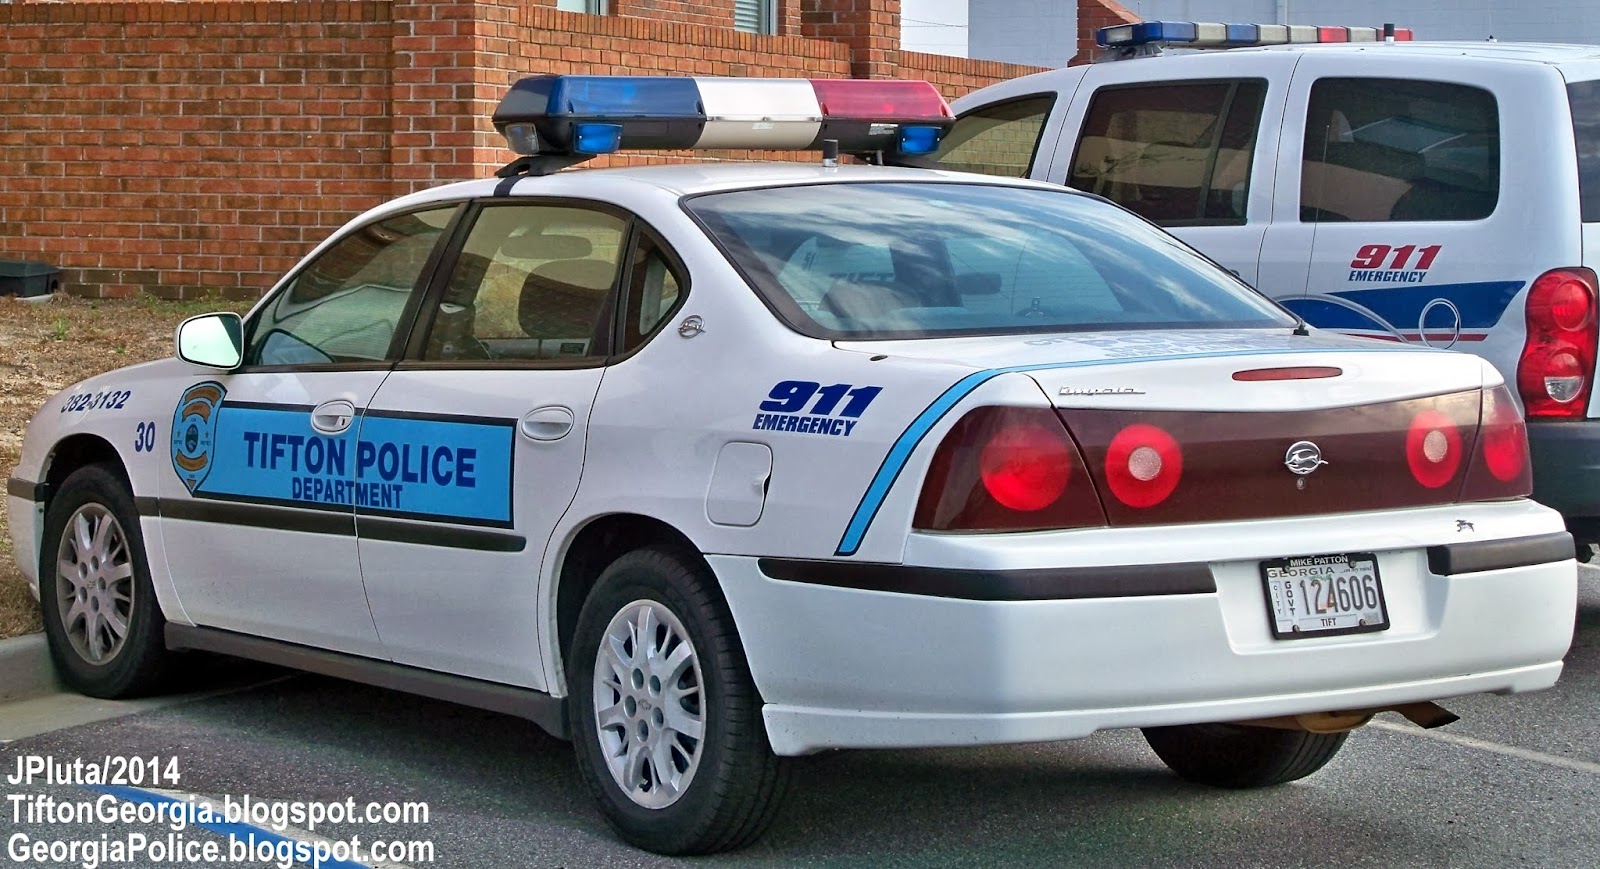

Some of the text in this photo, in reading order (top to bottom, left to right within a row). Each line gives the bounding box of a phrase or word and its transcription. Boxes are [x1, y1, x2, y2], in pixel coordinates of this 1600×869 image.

[1350, 244, 1442, 270] 911
[1348, 270, 1427, 283] EMERGENCY
[61, 390, 132, 413] 382-3132
[759, 380, 884, 418] 911
[134, 421, 156, 452] 30
[752, 413, 858, 437] EMERGENCY
[243, 431, 477, 488] TIFTON POLICE
[292, 476, 403, 509] DEPARTMENT
[1267, 566, 1335, 578] GEORGIA
[1290, 556, 1348, 568] MIKE PATTON
[1273, 585, 1282, 615] CITY
[1284, 581, 1295, 615] GOVT
[1300, 574, 1378, 615] 124606
[1320, 617, 1337, 627] TIFT
